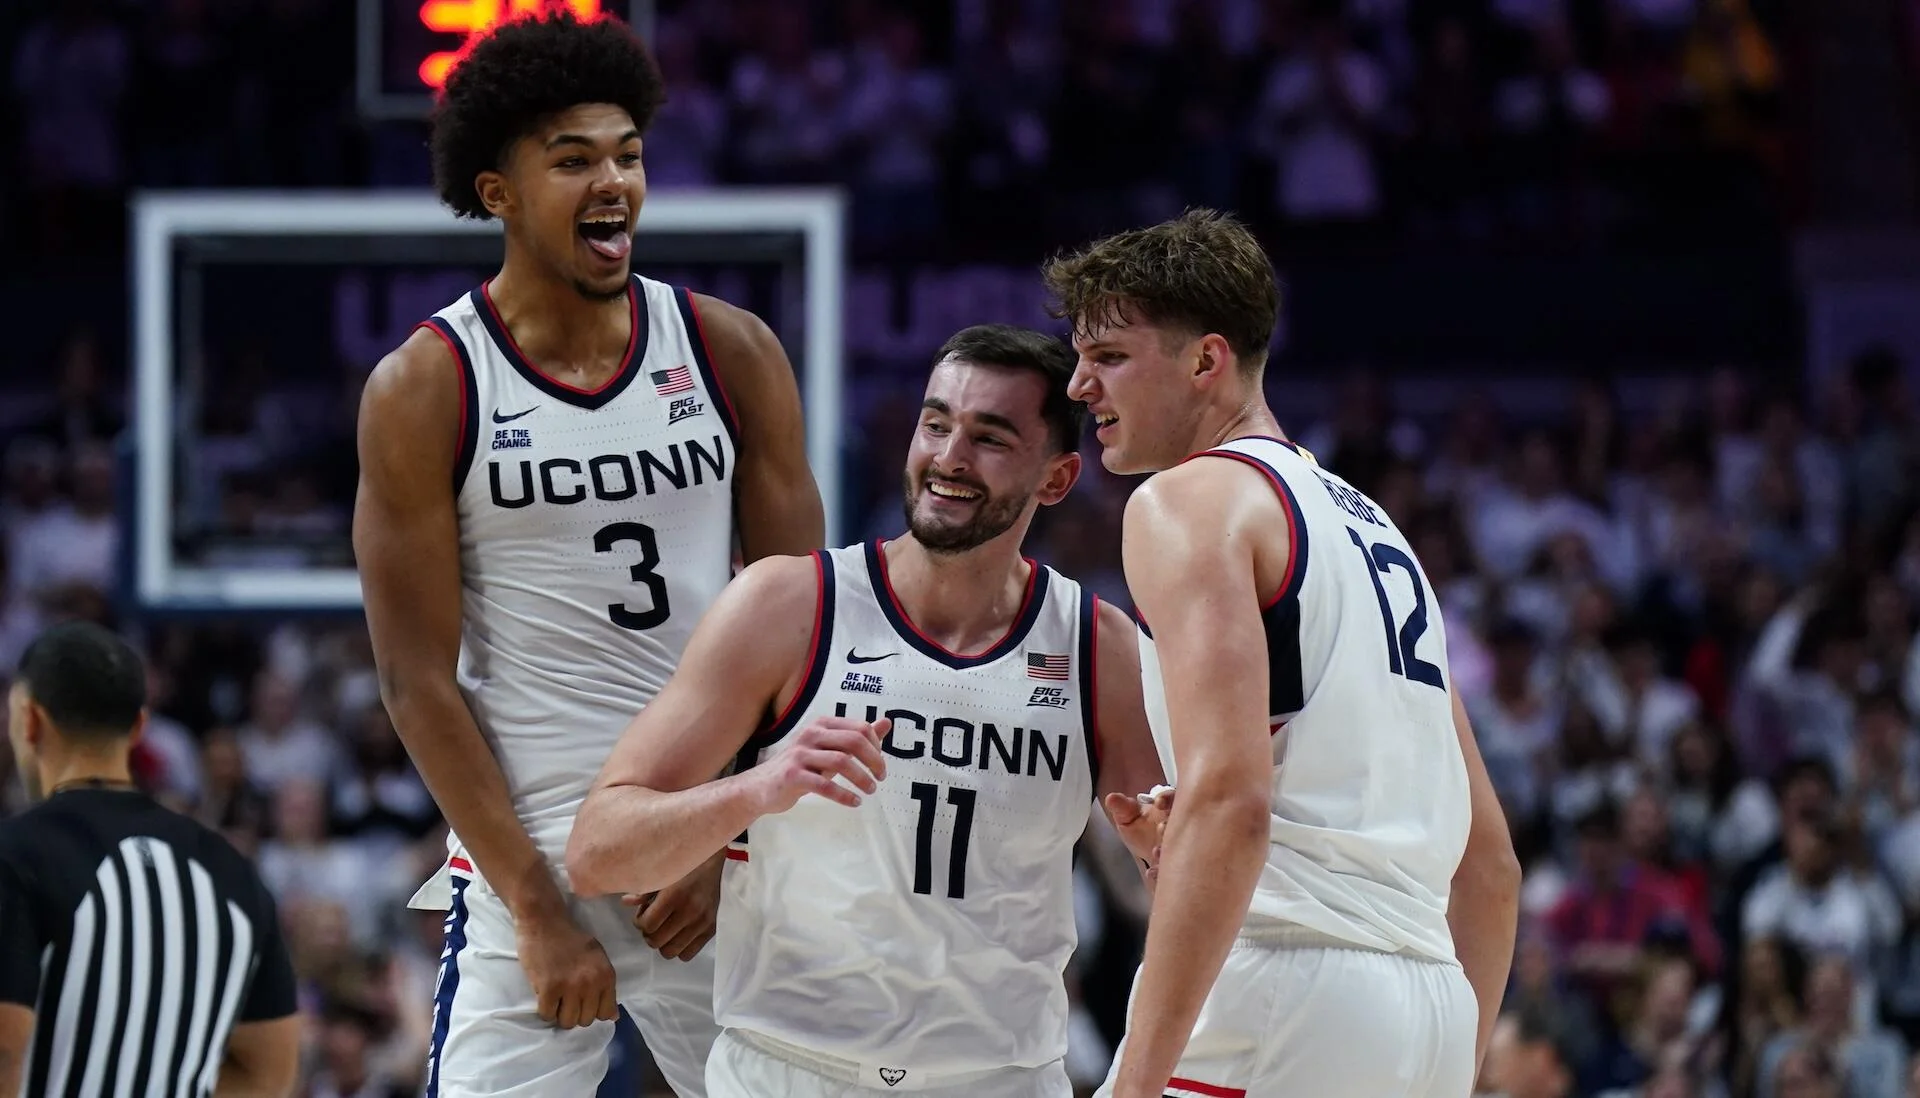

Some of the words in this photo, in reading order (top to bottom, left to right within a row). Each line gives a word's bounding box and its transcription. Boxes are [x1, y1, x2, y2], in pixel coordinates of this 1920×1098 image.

[668, 403, 704, 420] EAST
[669, 396, 695, 412] BIG
[495, 430, 508, 440] BE
[511, 429, 530, 439] THE
[491, 438, 533, 450] CHANGE
[488, 435, 725, 509] UCONN
[593, 521, 671, 631] 3
[1345, 525, 1447, 693] 12
[845, 671, 860, 682] BE
[862, 673, 883, 685] THE
[840, 680, 884, 695] CHANGE
[1032, 686, 1064, 698] BIG
[1028, 695, 1071, 707] EAST
[910, 781, 977, 899] 11
